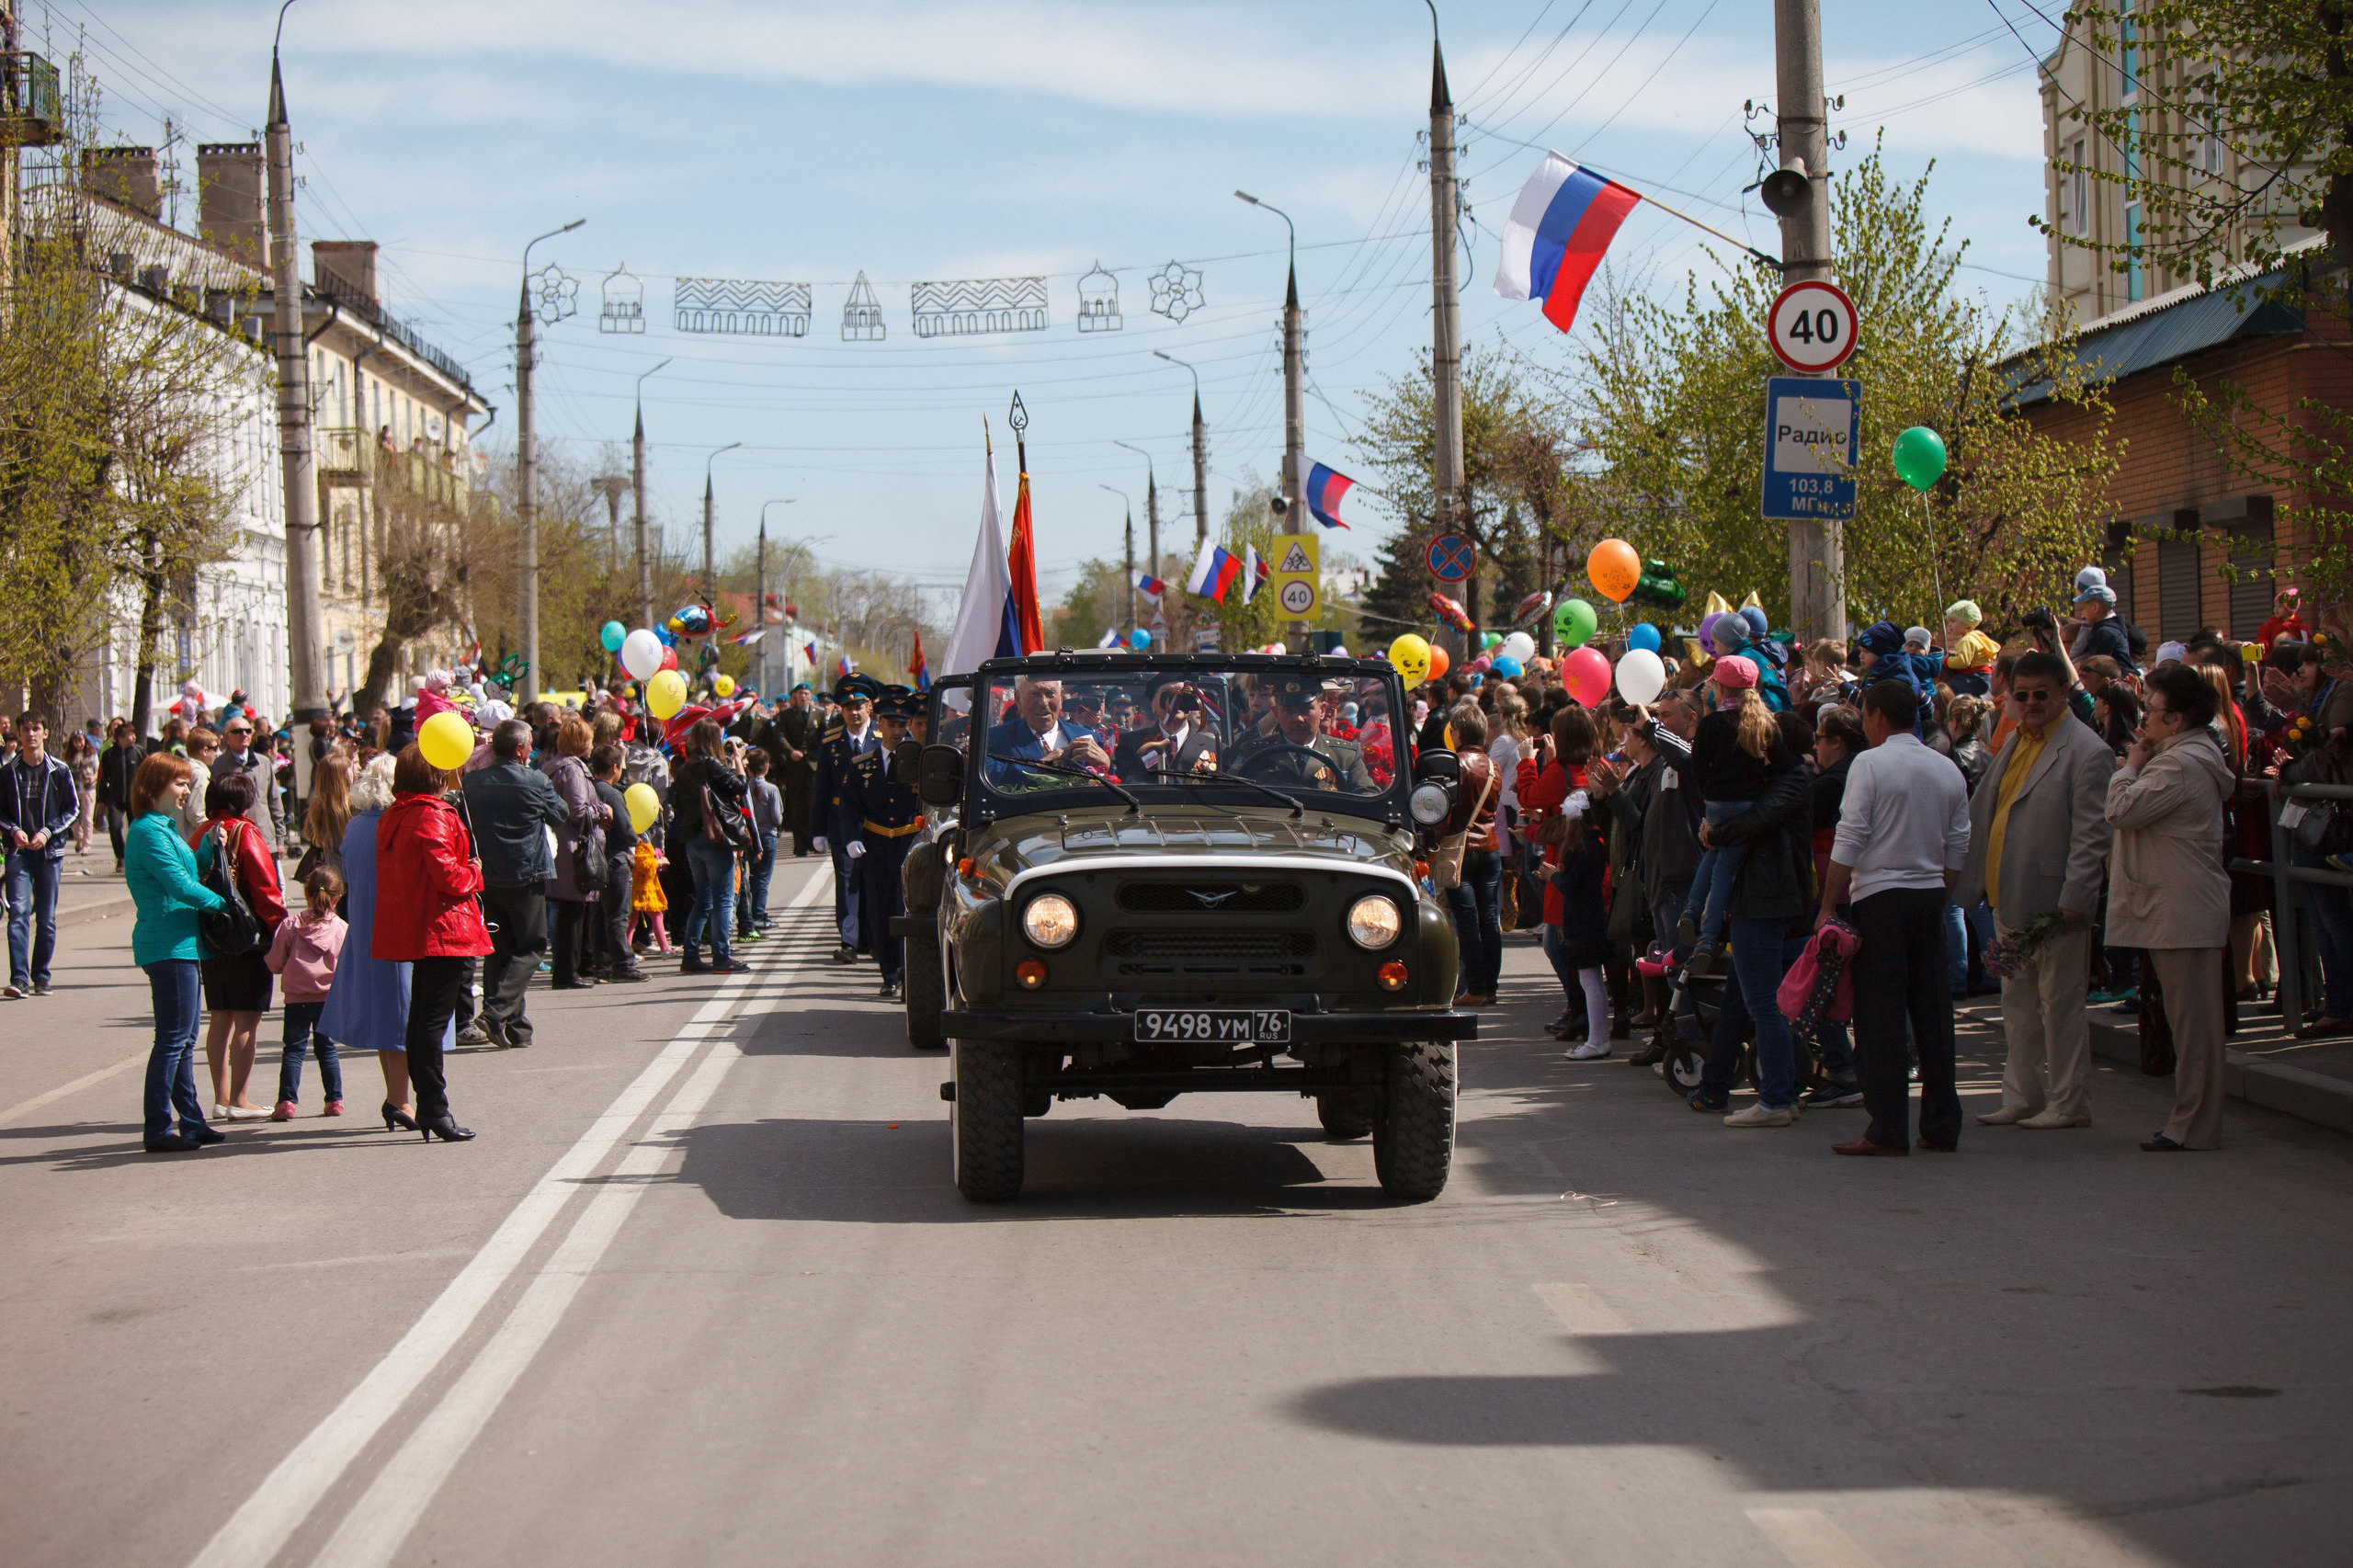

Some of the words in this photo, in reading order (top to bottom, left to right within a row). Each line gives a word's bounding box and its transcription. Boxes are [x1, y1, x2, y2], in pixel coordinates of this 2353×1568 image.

[1790, 308, 1838, 345] 40
[1779, 425, 1847, 446] Радио
[1790, 478, 1834, 495] 103,8
[1288, 590, 1307, 603] 40
[1146, 1013, 1211, 1039] 9498
[1218, 1018, 1250, 1039] УМ
[1256, 1013, 1282, 1032] 76
